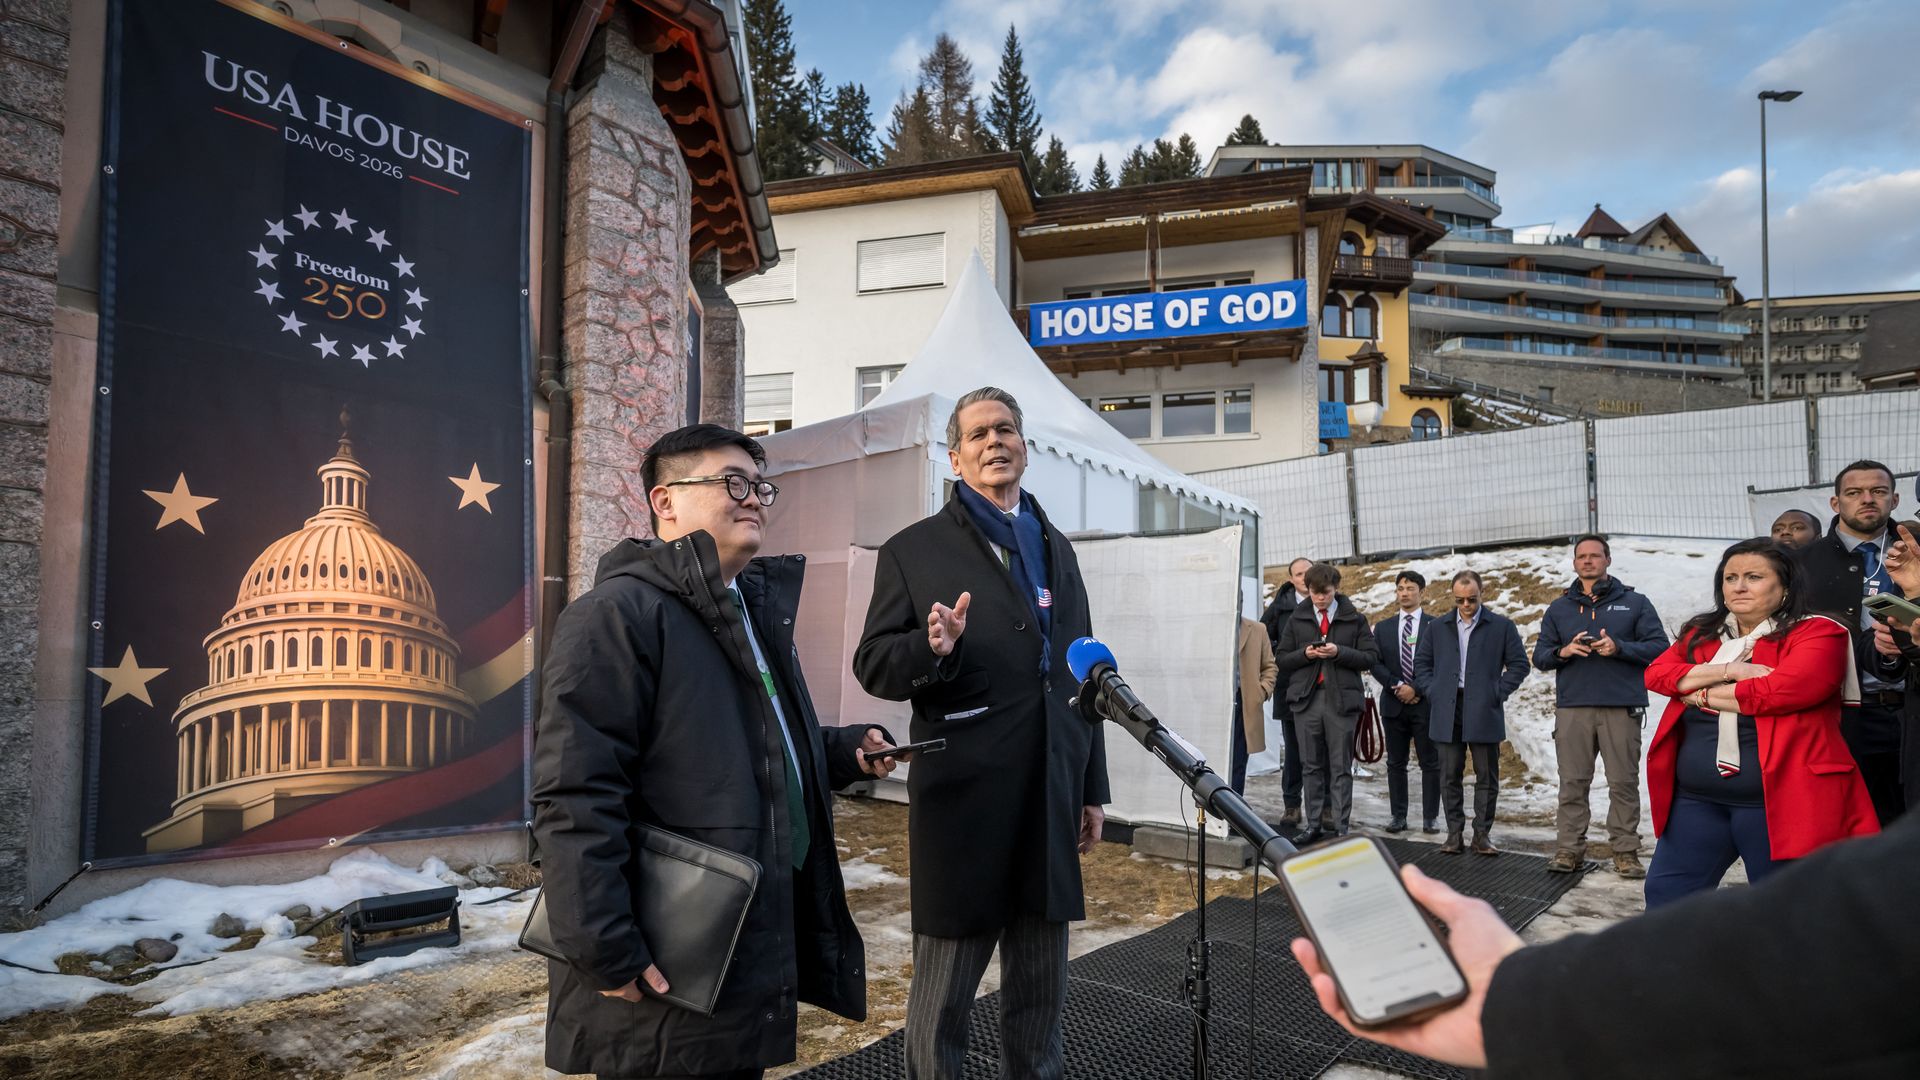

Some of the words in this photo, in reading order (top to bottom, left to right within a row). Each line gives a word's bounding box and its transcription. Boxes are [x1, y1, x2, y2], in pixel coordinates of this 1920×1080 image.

[202, 51, 307, 121] USA
[315, 95, 470, 180] HOUSE
[284, 126, 355, 163] DAVOS
[359, 153, 403, 180] 2026
[294, 252, 390, 291] Freedom
[302, 277, 386, 320] 250
[1041, 301, 1154, 338] HOUSE
[1164, 297, 1209, 328] OF
[1219, 290, 1297, 325] GOD
